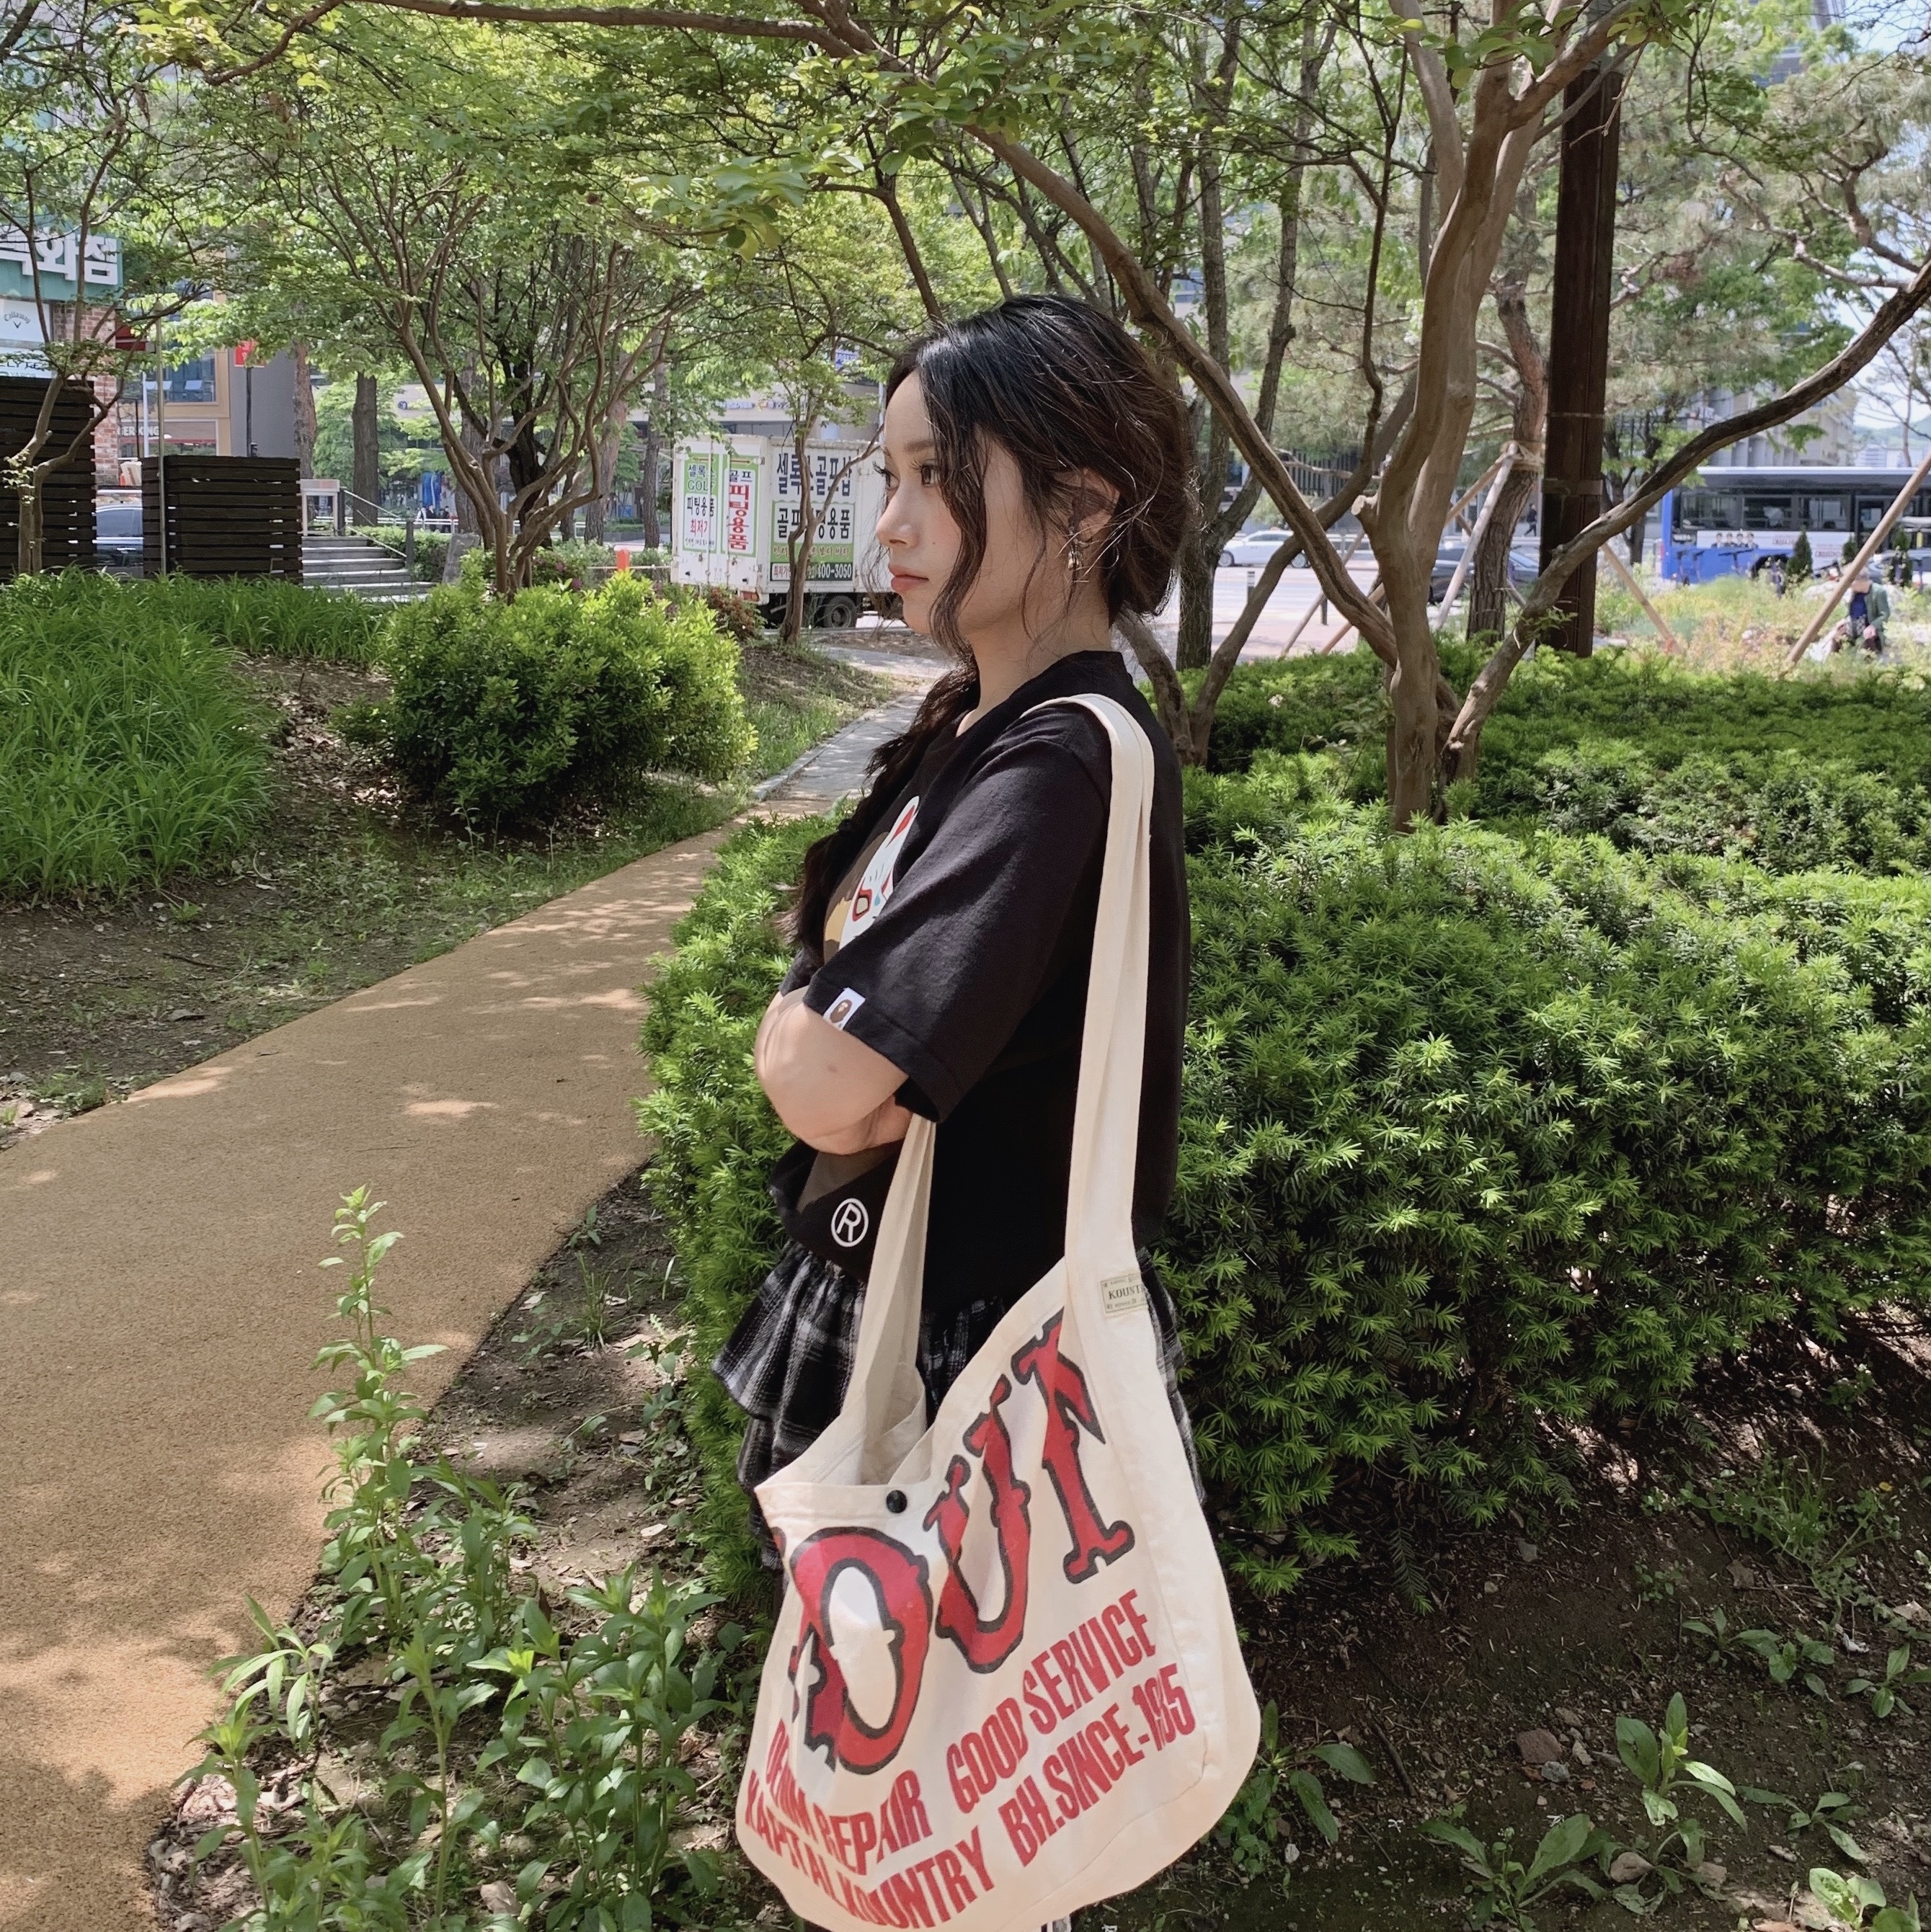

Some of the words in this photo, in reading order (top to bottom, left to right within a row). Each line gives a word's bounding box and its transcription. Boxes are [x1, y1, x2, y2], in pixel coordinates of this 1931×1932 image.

[138, 426, 159, 436] KNG
[729, 469, 753, 483] 골프
[688, 480, 715, 491] GOLF
[778, 507, 851, 540] 골프팅용품
[813, 1770, 933, 1875] REPAIR
[946, 1697, 1029, 1814] GOOD
[1023, 1588, 1156, 1735] SERVICE
